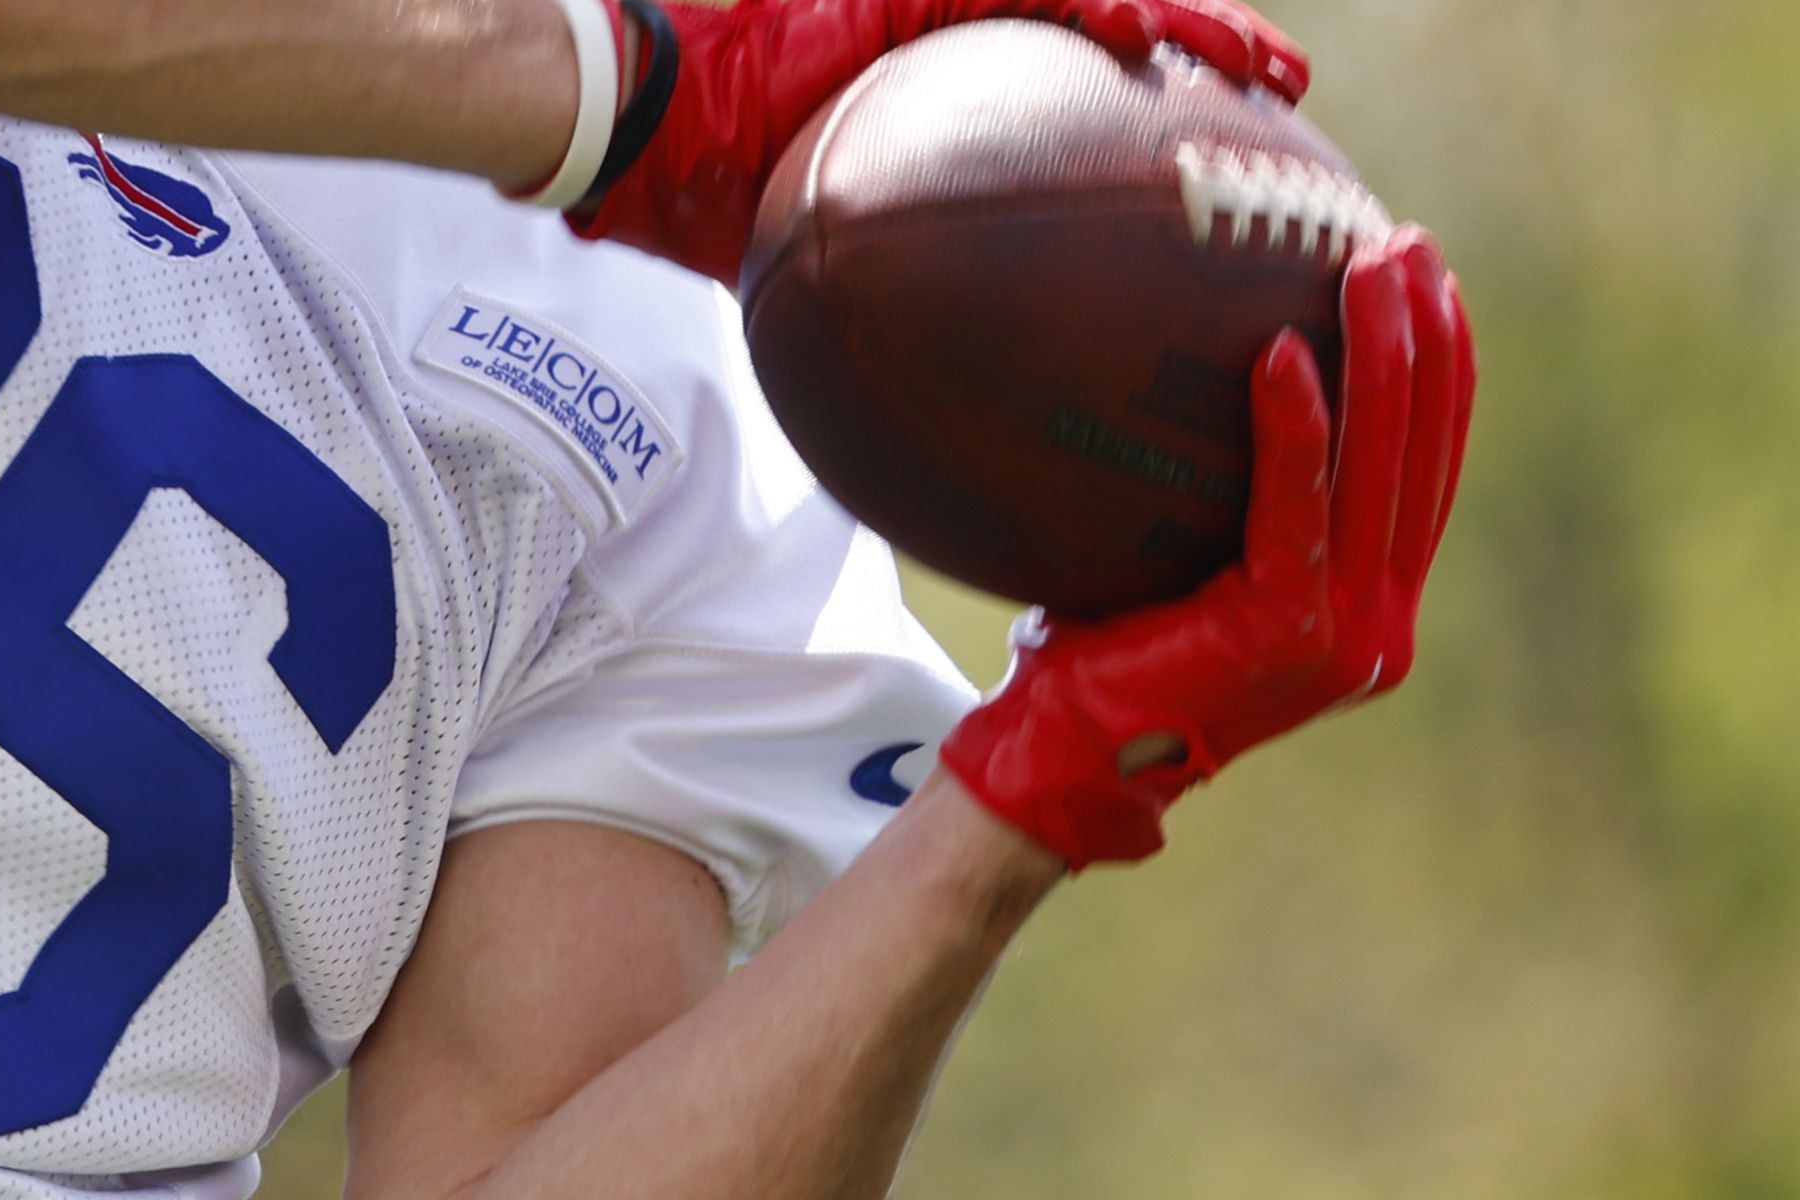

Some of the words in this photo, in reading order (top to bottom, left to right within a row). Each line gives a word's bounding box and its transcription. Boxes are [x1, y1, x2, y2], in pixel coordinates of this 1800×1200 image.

[460, 355, 483, 369] OF
[483, 364, 573, 428] OSTEOPATHIC
[571, 426, 619, 485] MEDICINE
[492, 356, 528, 383] LAKE
[529, 377, 558, 403] ERIE
[558, 398, 609, 451] COLLEGE
